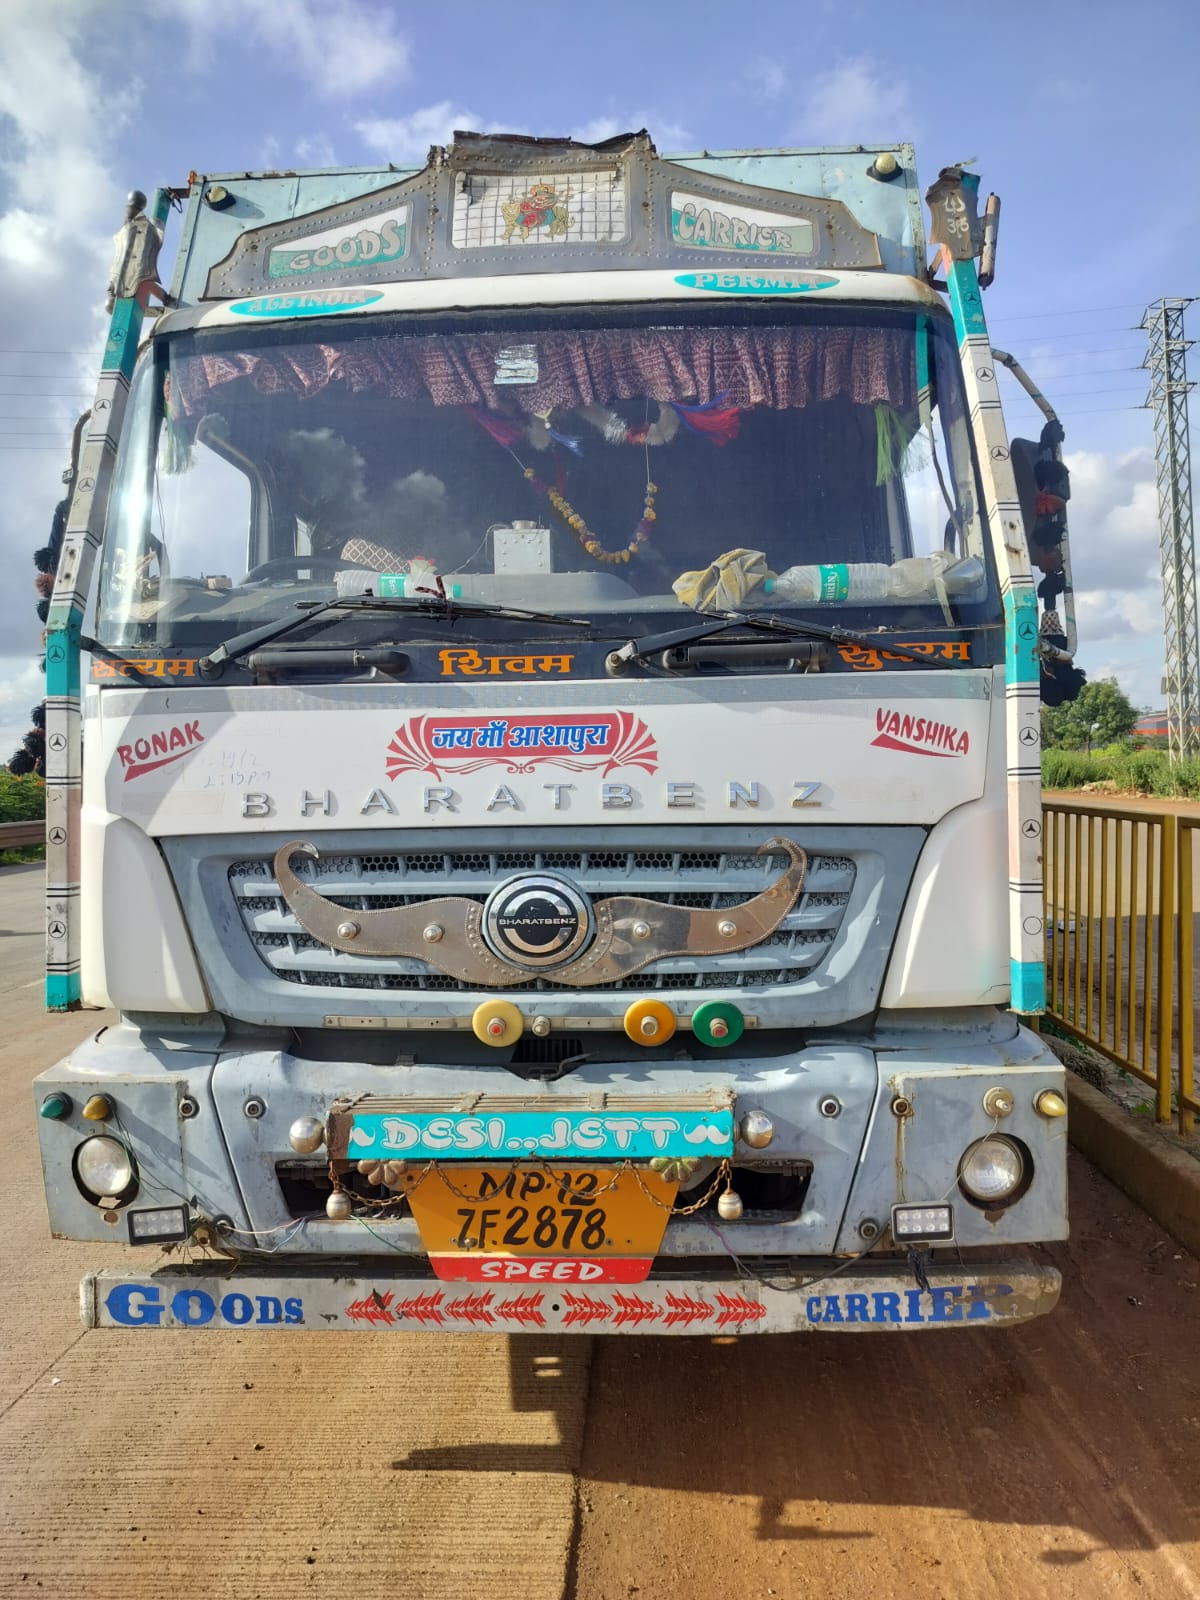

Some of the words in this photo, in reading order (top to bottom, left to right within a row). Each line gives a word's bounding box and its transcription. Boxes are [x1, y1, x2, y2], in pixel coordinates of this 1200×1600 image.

[677, 202, 792, 249] CARRIER
[290, 219, 402, 270] GOODS
[694, 272, 820, 289] PERMIT
[248, 296, 294, 313] ALL
[438, 648, 576, 676] शिवम
[117, 719, 205, 768] RONAK
[433, 727, 476, 749] जय
[509, 724, 611, 753] आशापुरा
[876, 707, 970, 756] VANSHIKA
[241, 780, 823, 818] BHARATBENZ
[498, 917, 577, 926] BHARATBENZ
[481, 1260, 605, 1281] SPEED
[104, 1283, 304, 1326] GOODS
